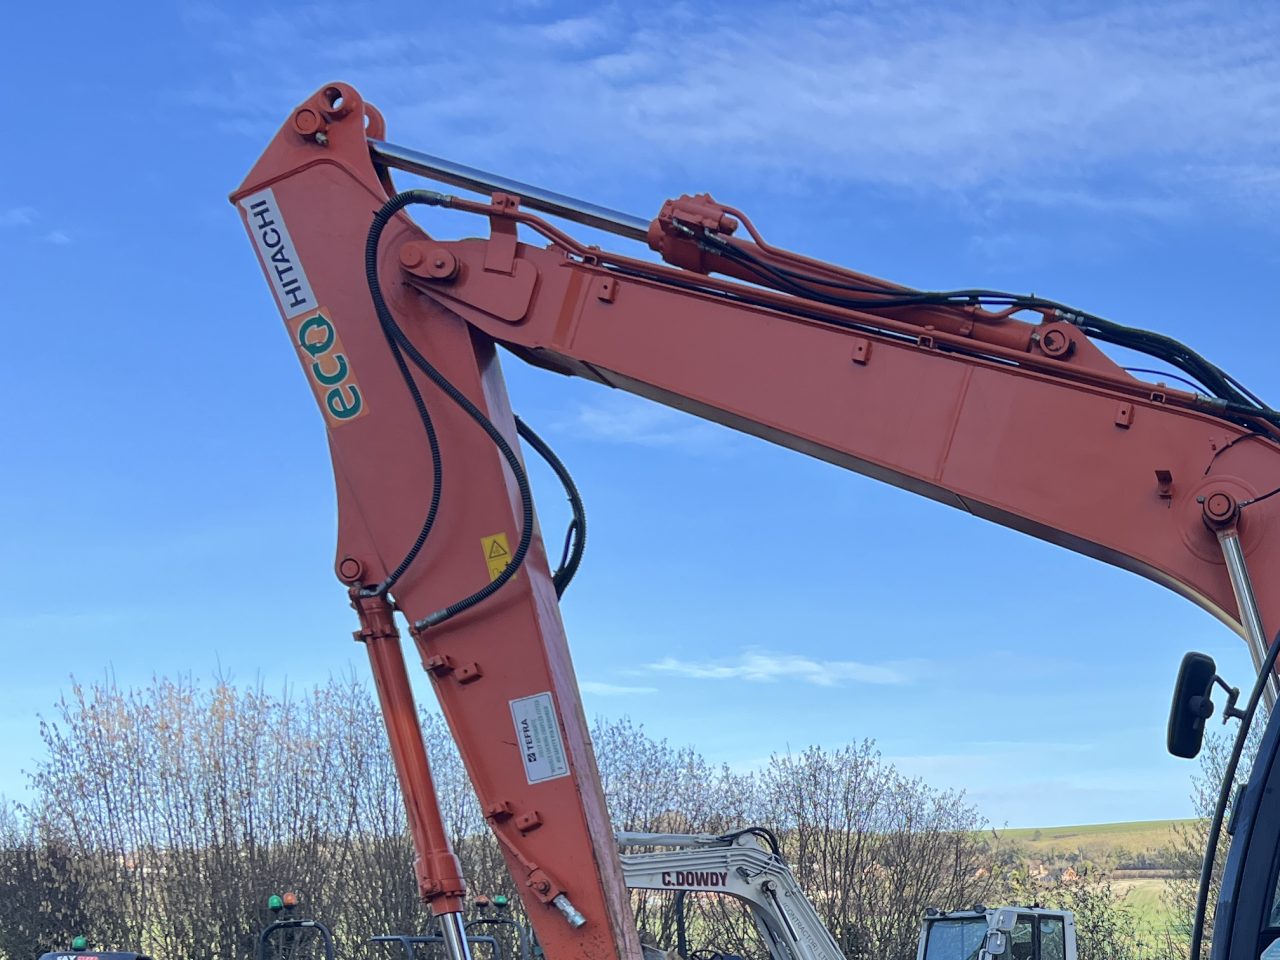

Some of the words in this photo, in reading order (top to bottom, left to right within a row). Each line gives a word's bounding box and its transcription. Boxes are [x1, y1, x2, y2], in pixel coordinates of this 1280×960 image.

[250, 199, 307, 309] HITACHI
[520, 718, 534, 751] TEFRA
[661, 871, 728, 887] C.DOWDY
